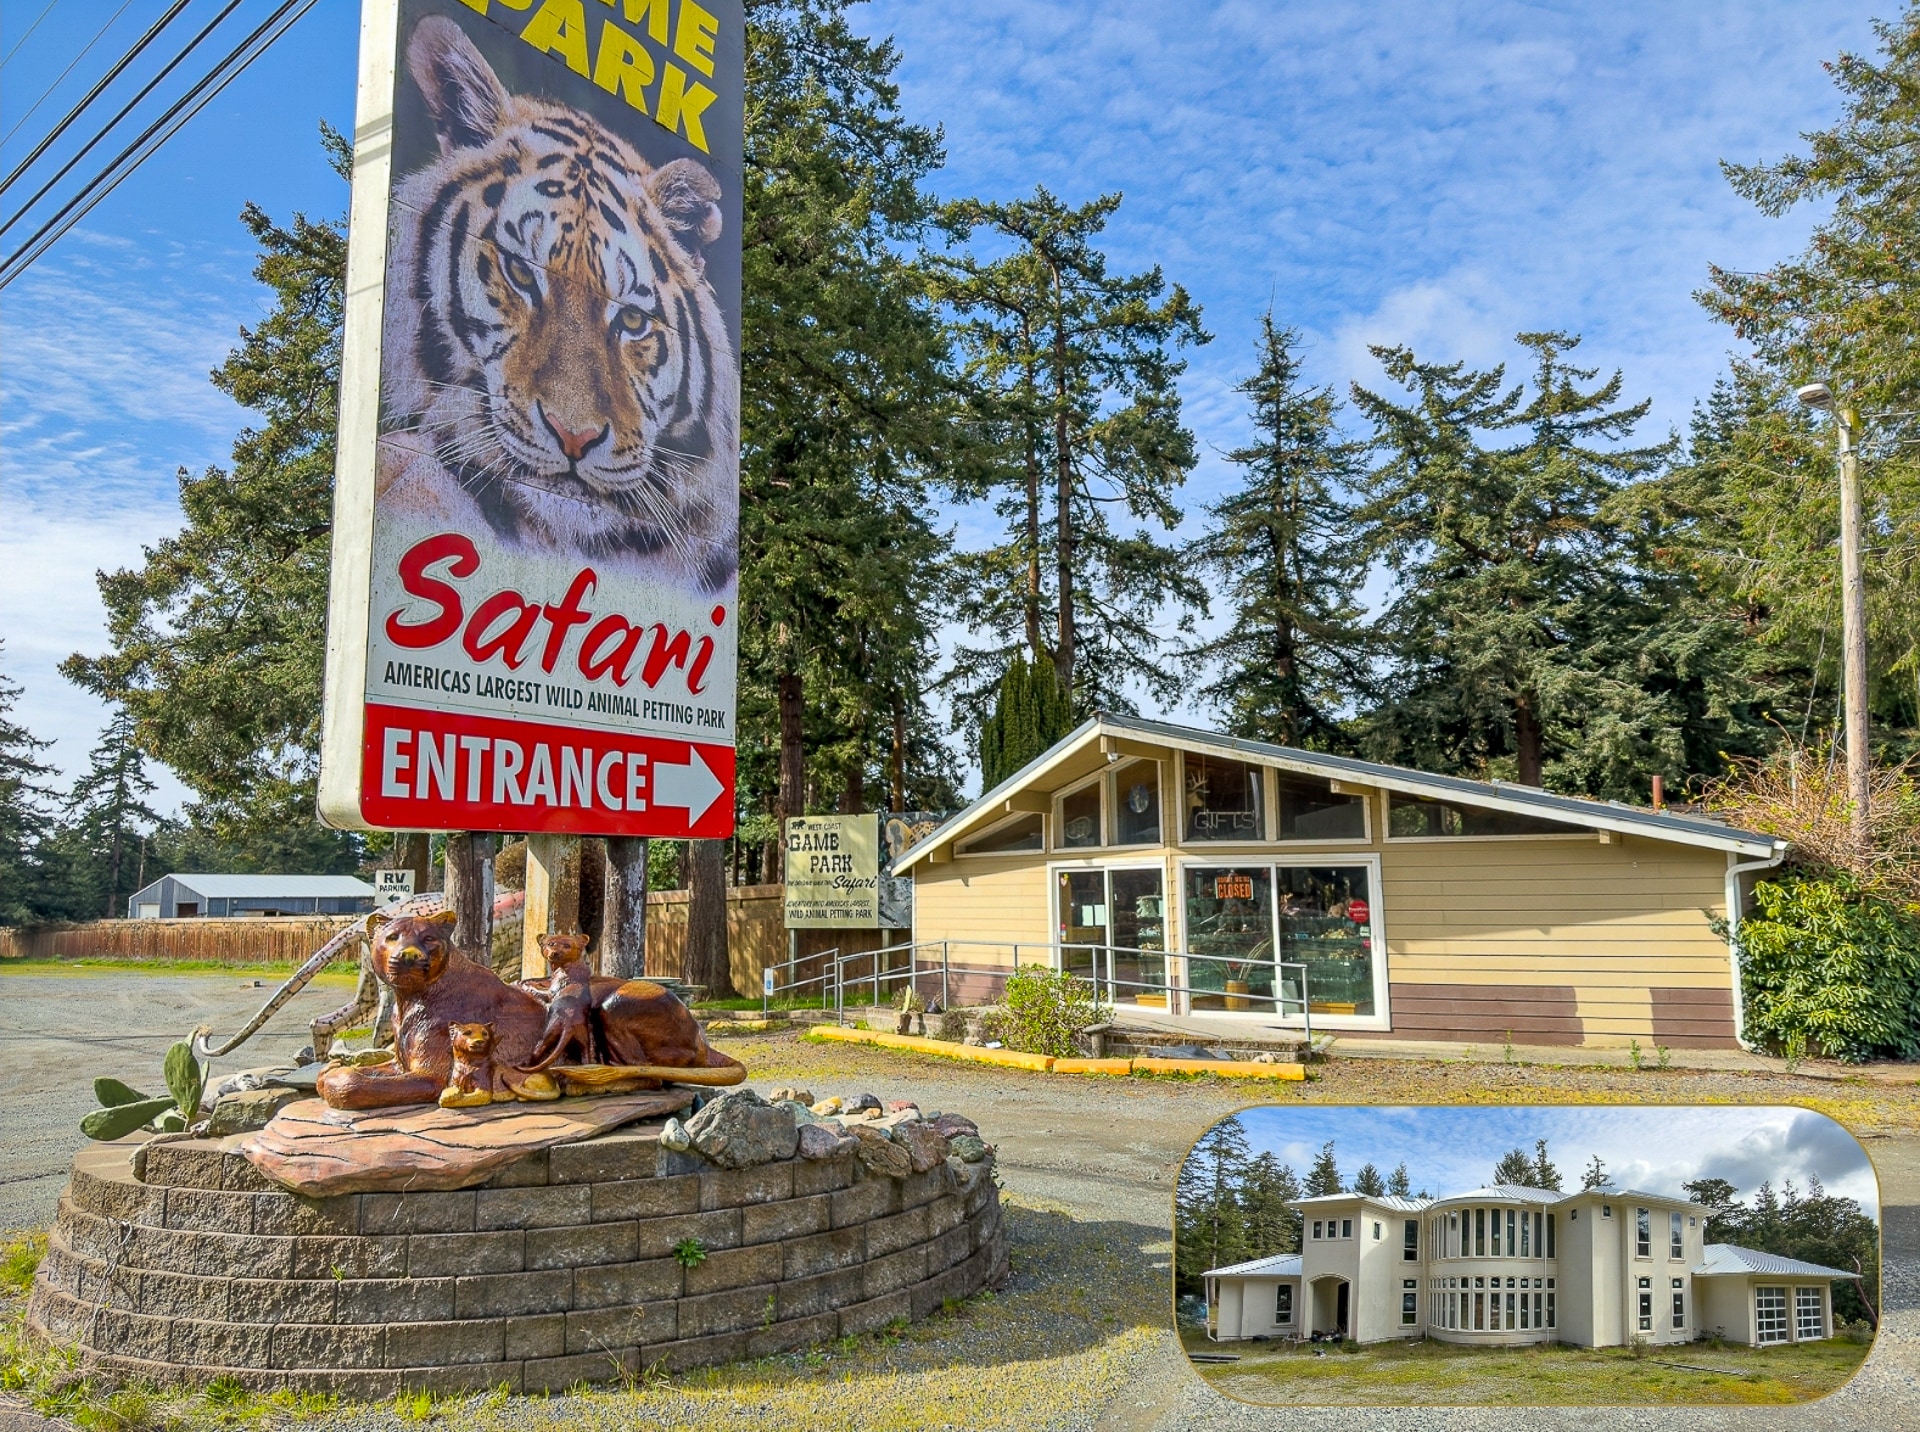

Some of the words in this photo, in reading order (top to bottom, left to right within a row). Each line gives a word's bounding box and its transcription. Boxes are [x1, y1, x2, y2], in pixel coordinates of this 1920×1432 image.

[454, 0, 718, 155] ARK
[385, 533, 726, 695] Safari
[384, 661, 471, 694] AMERICAS
[476, 674, 541, 704] LARGEST
[546, 685, 583, 710] WILD
[587, 691, 639, 719] ANIMAL
[643, 699, 693, 725] PETTING
[697, 707, 726, 729] PARK
[381, 726, 647, 812] ENTRANCE
[807, 823, 822, 831] WEST
[824, 822, 841, 831] COAST
[1194, 811, 1255, 829] GIFTS
[789, 833, 839, 851] GAME
[810, 854, 853, 873] PARK
[384, 872, 406, 883] RV
[832, 875, 877, 895] Safari
[380, 884, 410, 893] PARKING
[1218, 883, 1251, 899] CLOSED
[788, 909, 804, 919] WILD
[804, 909, 828, 919] ANIMAL
[829, 909, 853, 919] PETTING
[855, 908, 873, 918] PARK
